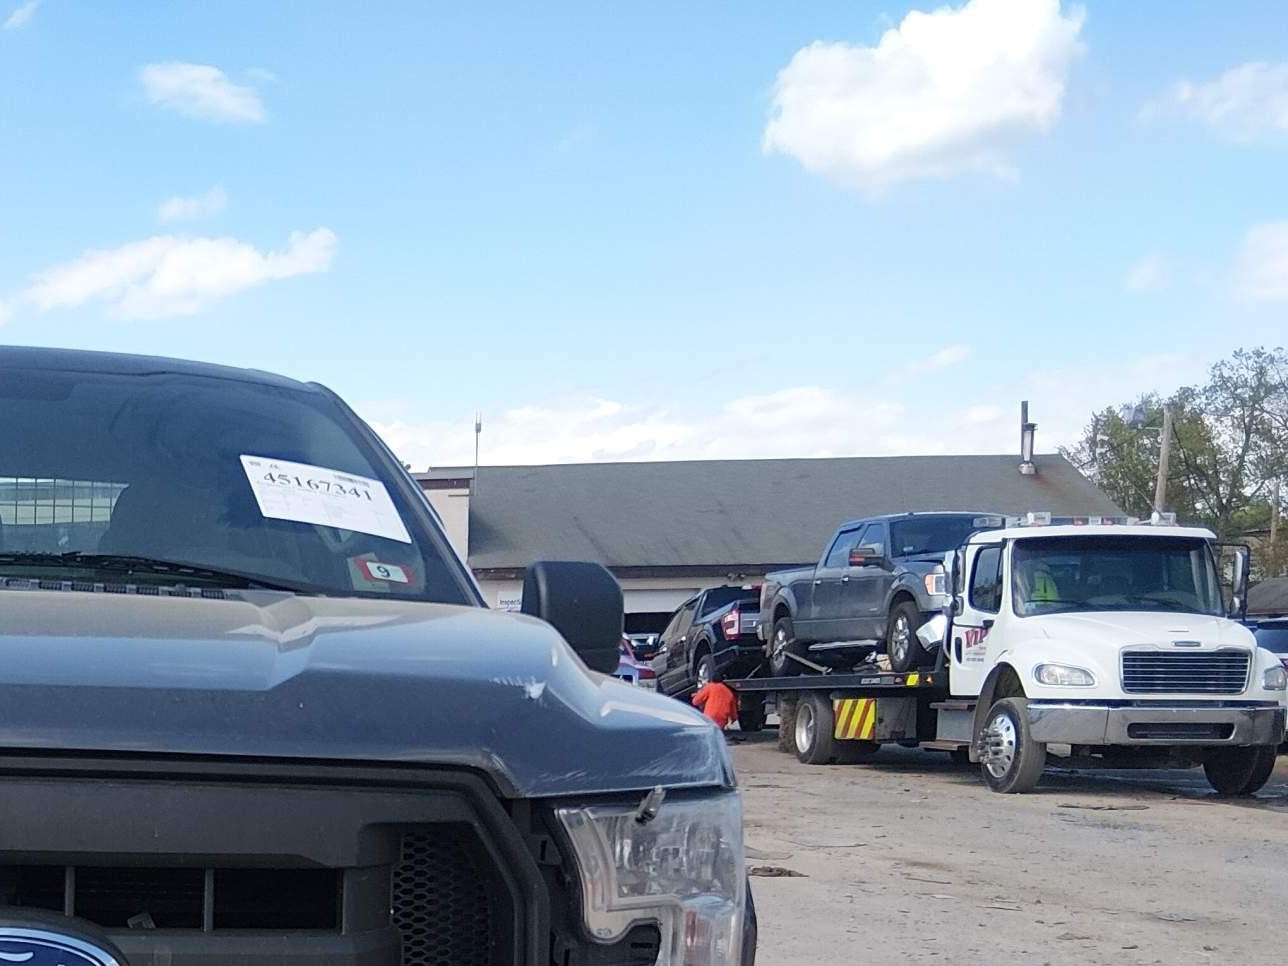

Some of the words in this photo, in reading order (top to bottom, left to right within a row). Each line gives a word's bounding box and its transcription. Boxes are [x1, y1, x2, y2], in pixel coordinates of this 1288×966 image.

[263, 471, 372, 501] 45167341
[376, 565, 390, 578] 9
[965, 627, 988, 648] VIP
